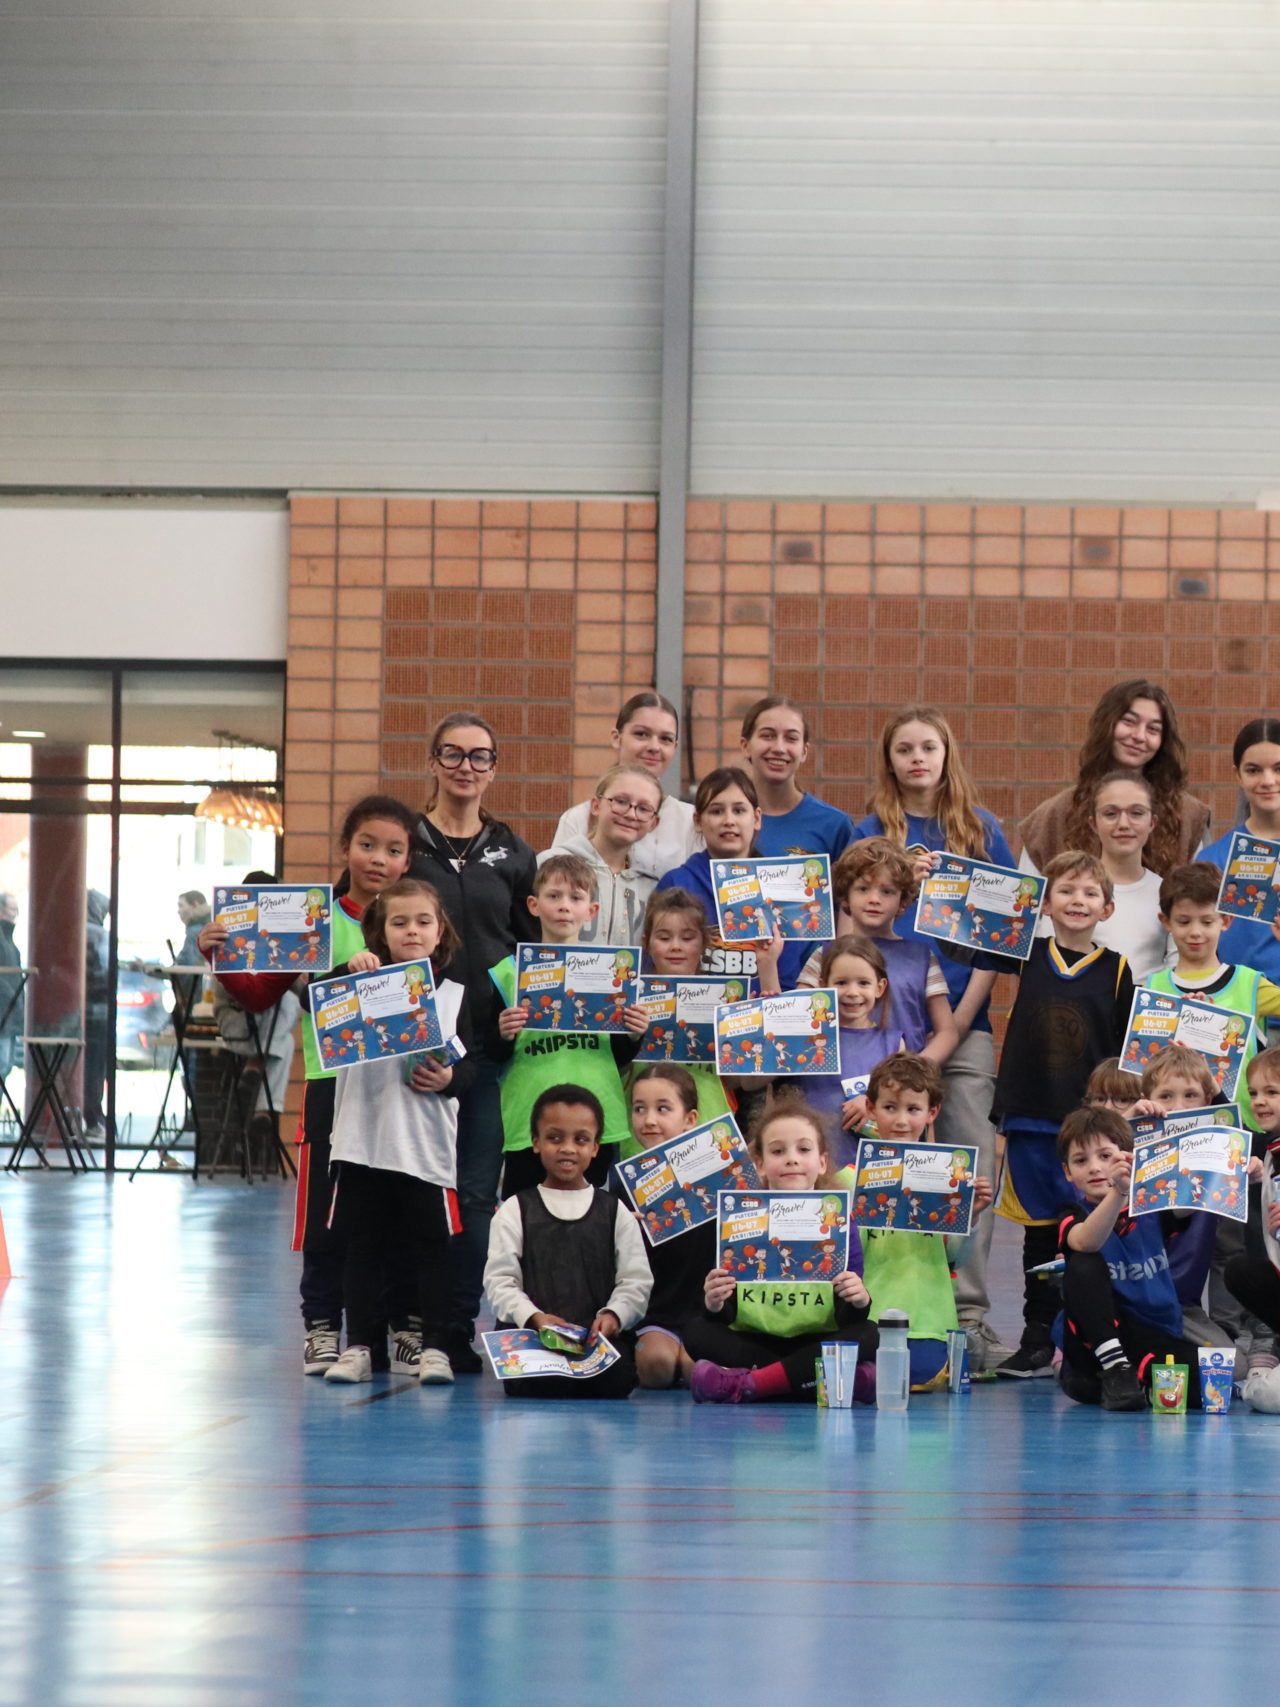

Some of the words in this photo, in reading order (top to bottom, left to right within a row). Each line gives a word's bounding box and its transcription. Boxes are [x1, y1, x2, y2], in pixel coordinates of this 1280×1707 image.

[1240, 864, 1264, 872] U6-U7
[727, 885, 750, 895] U6-U7
[934, 882, 958, 891] U6-U7
[223, 913, 247, 924] U6-U7
[529, 972, 554, 982] U6-U7
[325, 1004, 349, 1019] U6-U7
[1143, 1019, 1167, 1027] U6-U7
[868, 1169, 892, 1179] U6-U7
[642, 1175, 665, 1195] U6-U7
[731, 1220, 757, 1231] U6-U7
[742, 1288, 825, 1307] KIPSTA
